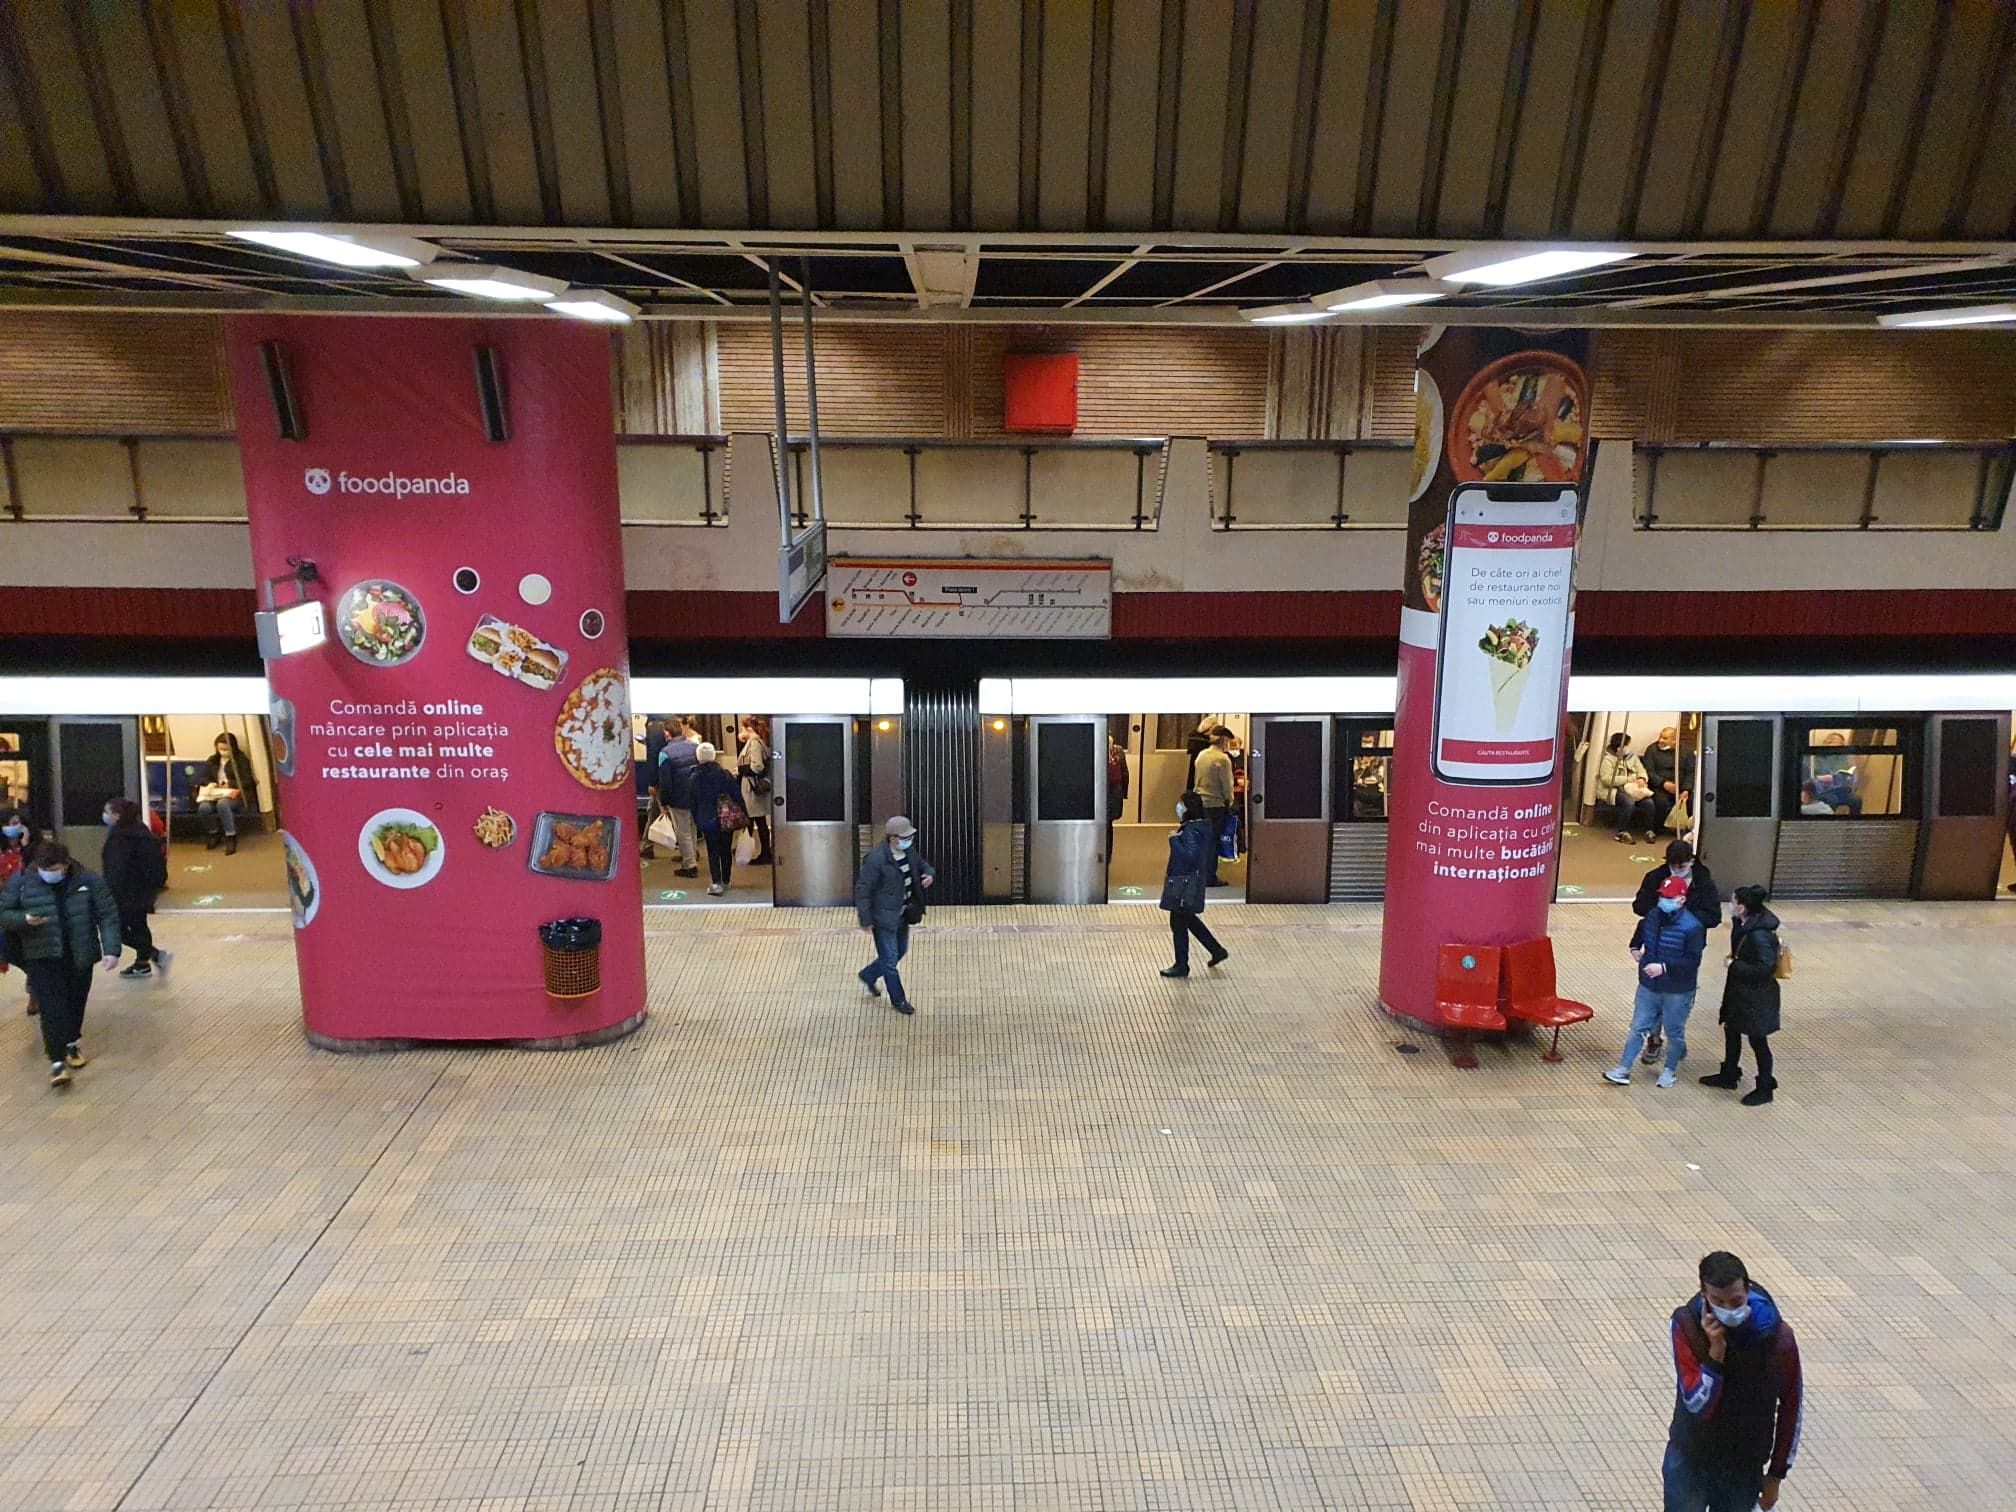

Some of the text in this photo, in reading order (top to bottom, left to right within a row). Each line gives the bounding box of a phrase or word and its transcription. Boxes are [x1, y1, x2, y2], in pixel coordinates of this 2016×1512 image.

[338, 471, 469, 499] foodpanda
[1501, 532, 1553, 545] foodpanda
[1471, 567, 1487, 578] De
[1489, 567, 1513, 578] câte
[1515, 567, 1530, 578] ori
[1532, 567, 1541, 578] ai
[1469, 581, 1561, 592] de restaurante noi
[1466, 598, 1485, 606] sau
[1488, 597, 1529, 607] meniuri
[329, 699, 484, 716] Comandă online
[309, 721, 509, 740] mâncare prin aplicația
[327, 742, 494, 758] cu cele mai multe
[322, 763, 509, 783] restaurante din oraș
[1428, 801, 1553, 820] Comandă online
[1418, 819, 1441, 836] din
[1447, 825, 1518, 843] aplicația
[1522, 828, 1538, 839] cu
[1416, 841, 1441, 856] mai
[1447, 846, 1496, 860] multe
[1433, 861, 1546, 883] internaționale
